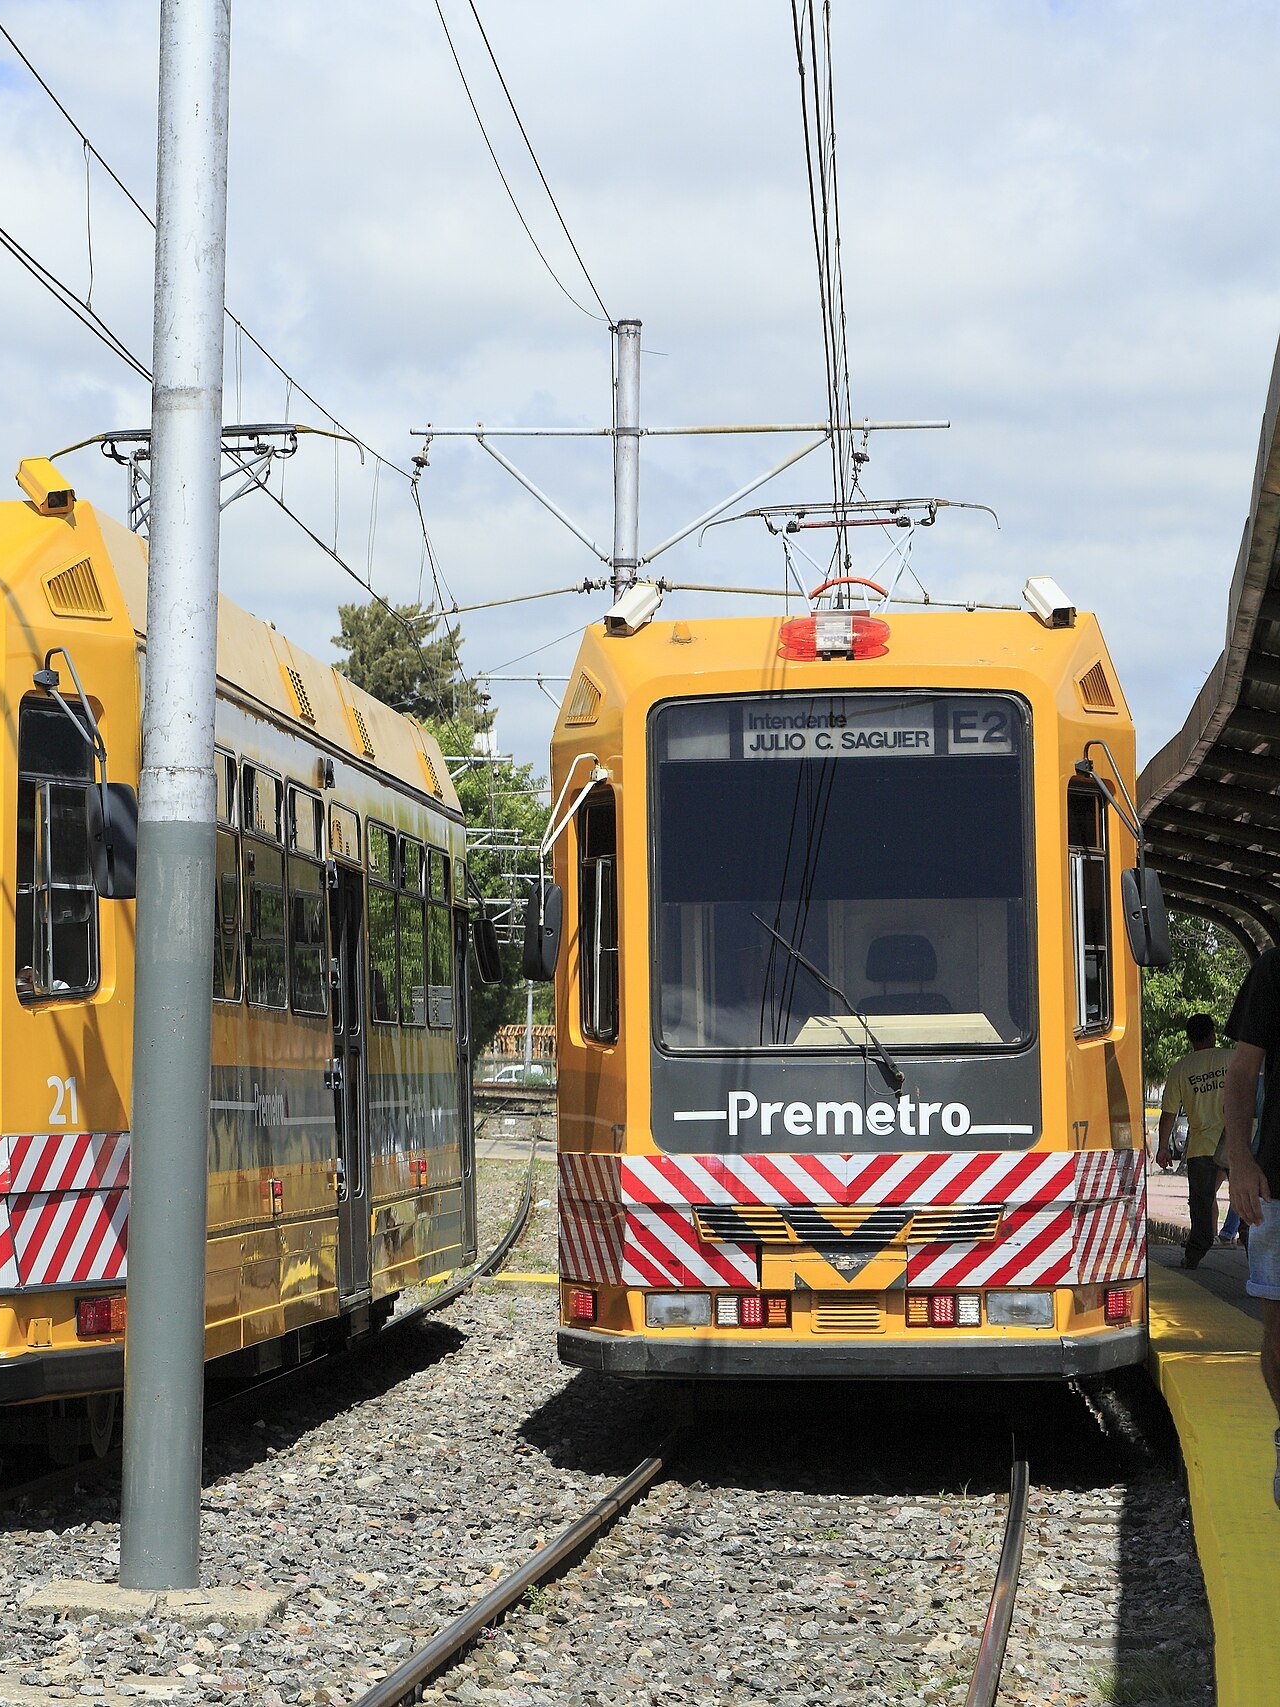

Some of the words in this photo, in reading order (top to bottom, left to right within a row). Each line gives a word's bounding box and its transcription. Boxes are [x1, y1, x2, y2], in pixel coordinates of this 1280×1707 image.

[749, 712, 847, 730] Intendente
[952, 710, 1008, 744] E2
[750, 733, 805, 751] JULIO
[815, 732, 834, 750] C.
[841, 730, 930, 749] SAGUIER
[47, 1075, 79, 1125] 21
[1193, 1080, 1225, 1095] Públic
[728, 1090, 971, 1136] Premetro
[1072, 1120, 1089, 1151] 17
